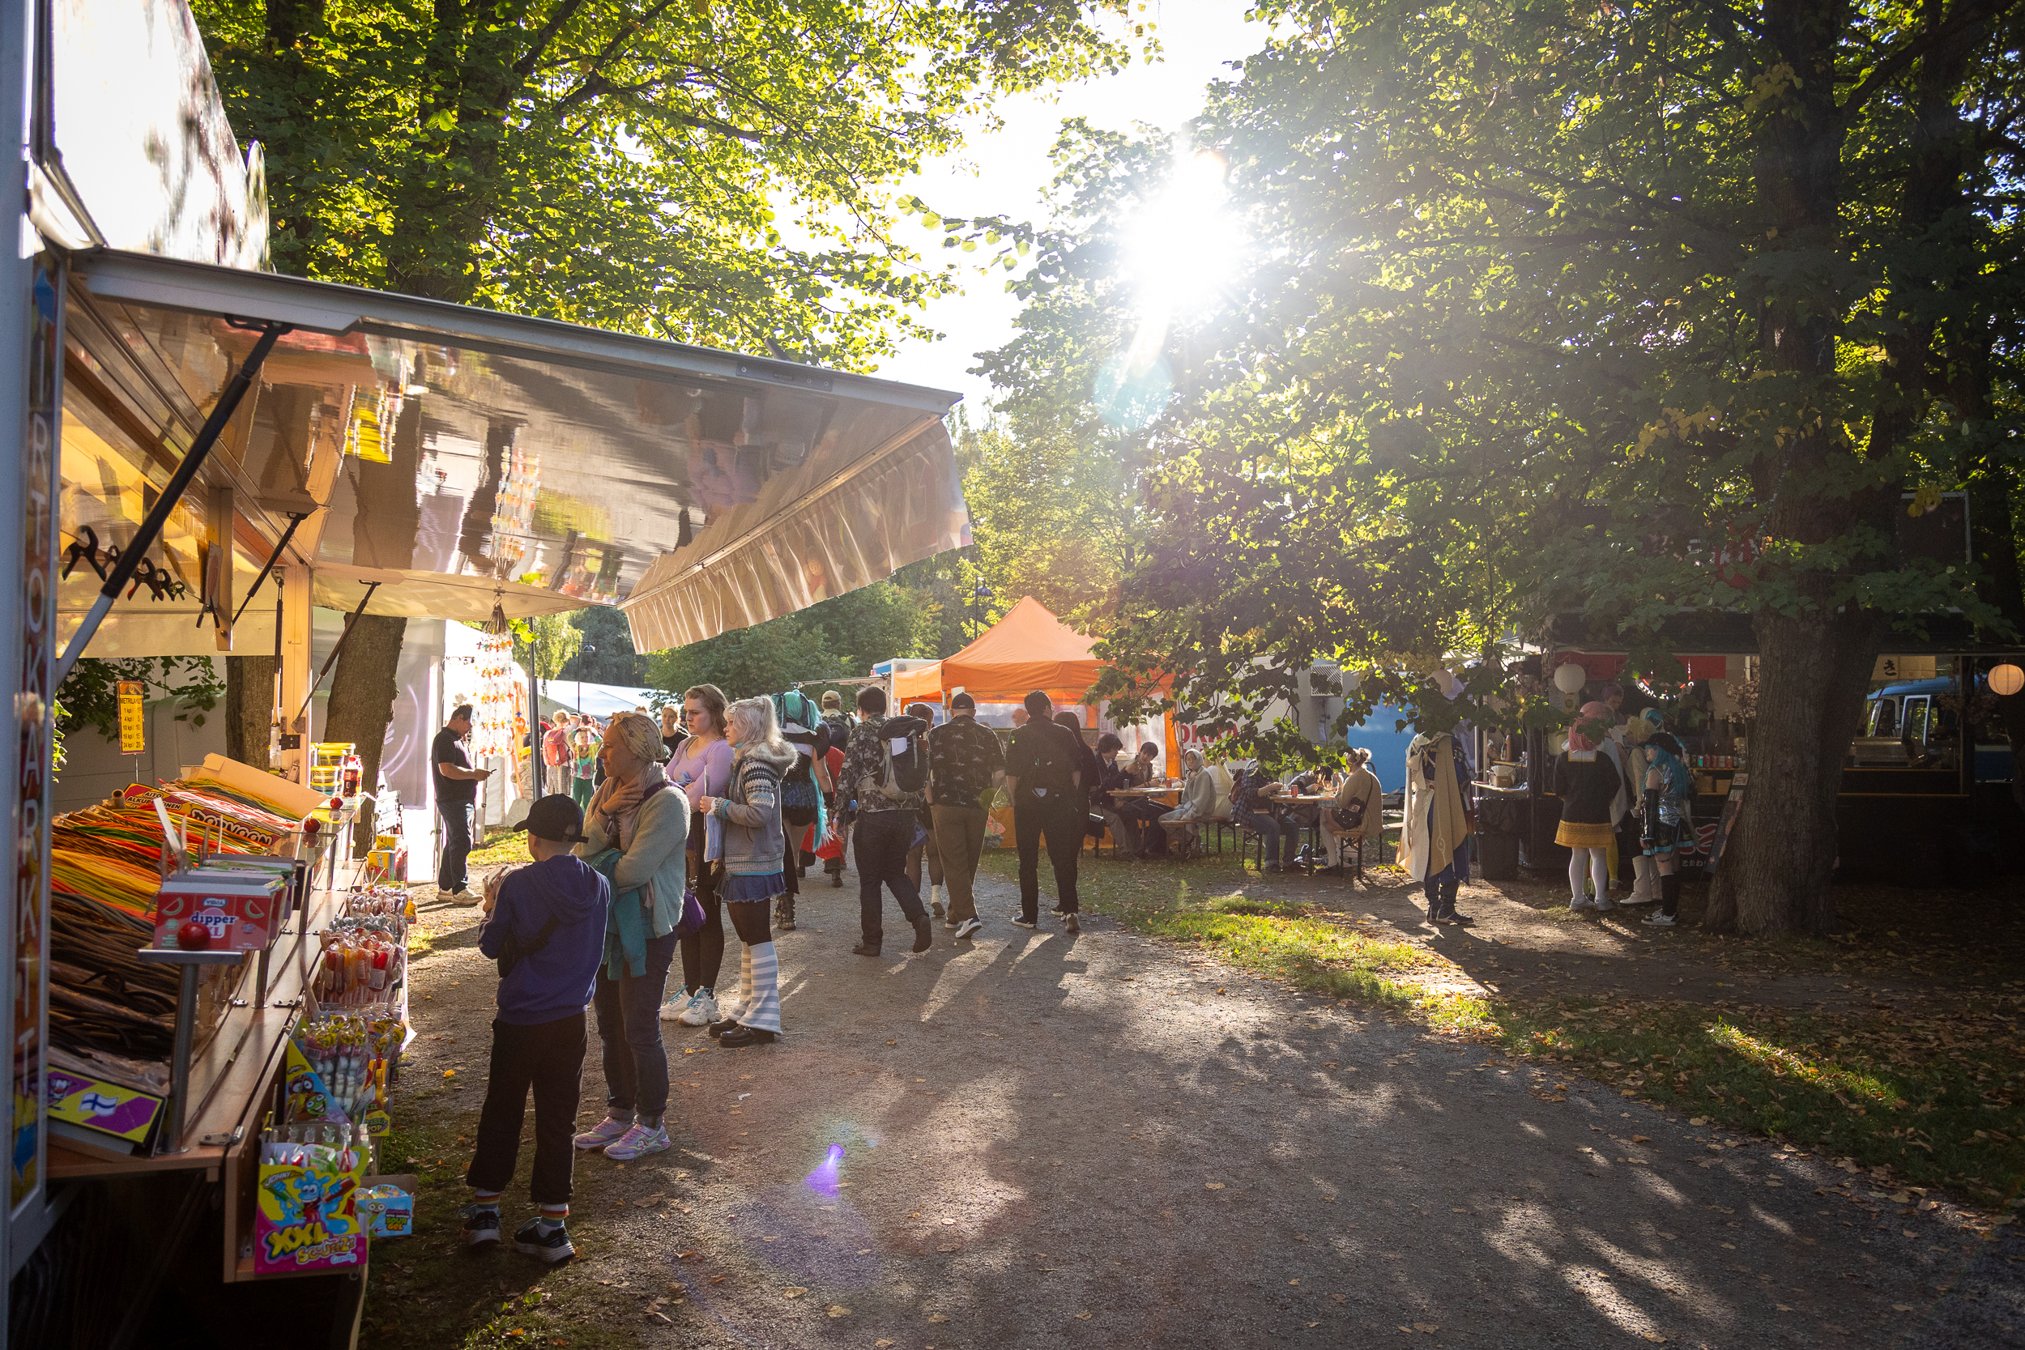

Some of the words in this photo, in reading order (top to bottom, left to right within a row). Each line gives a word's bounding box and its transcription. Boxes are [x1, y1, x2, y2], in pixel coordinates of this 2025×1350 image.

[126, 796, 182, 809] ALKUPINEN
[191, 912, 236, 925] dipper
[268, 1222, 329, 1257] XXL
